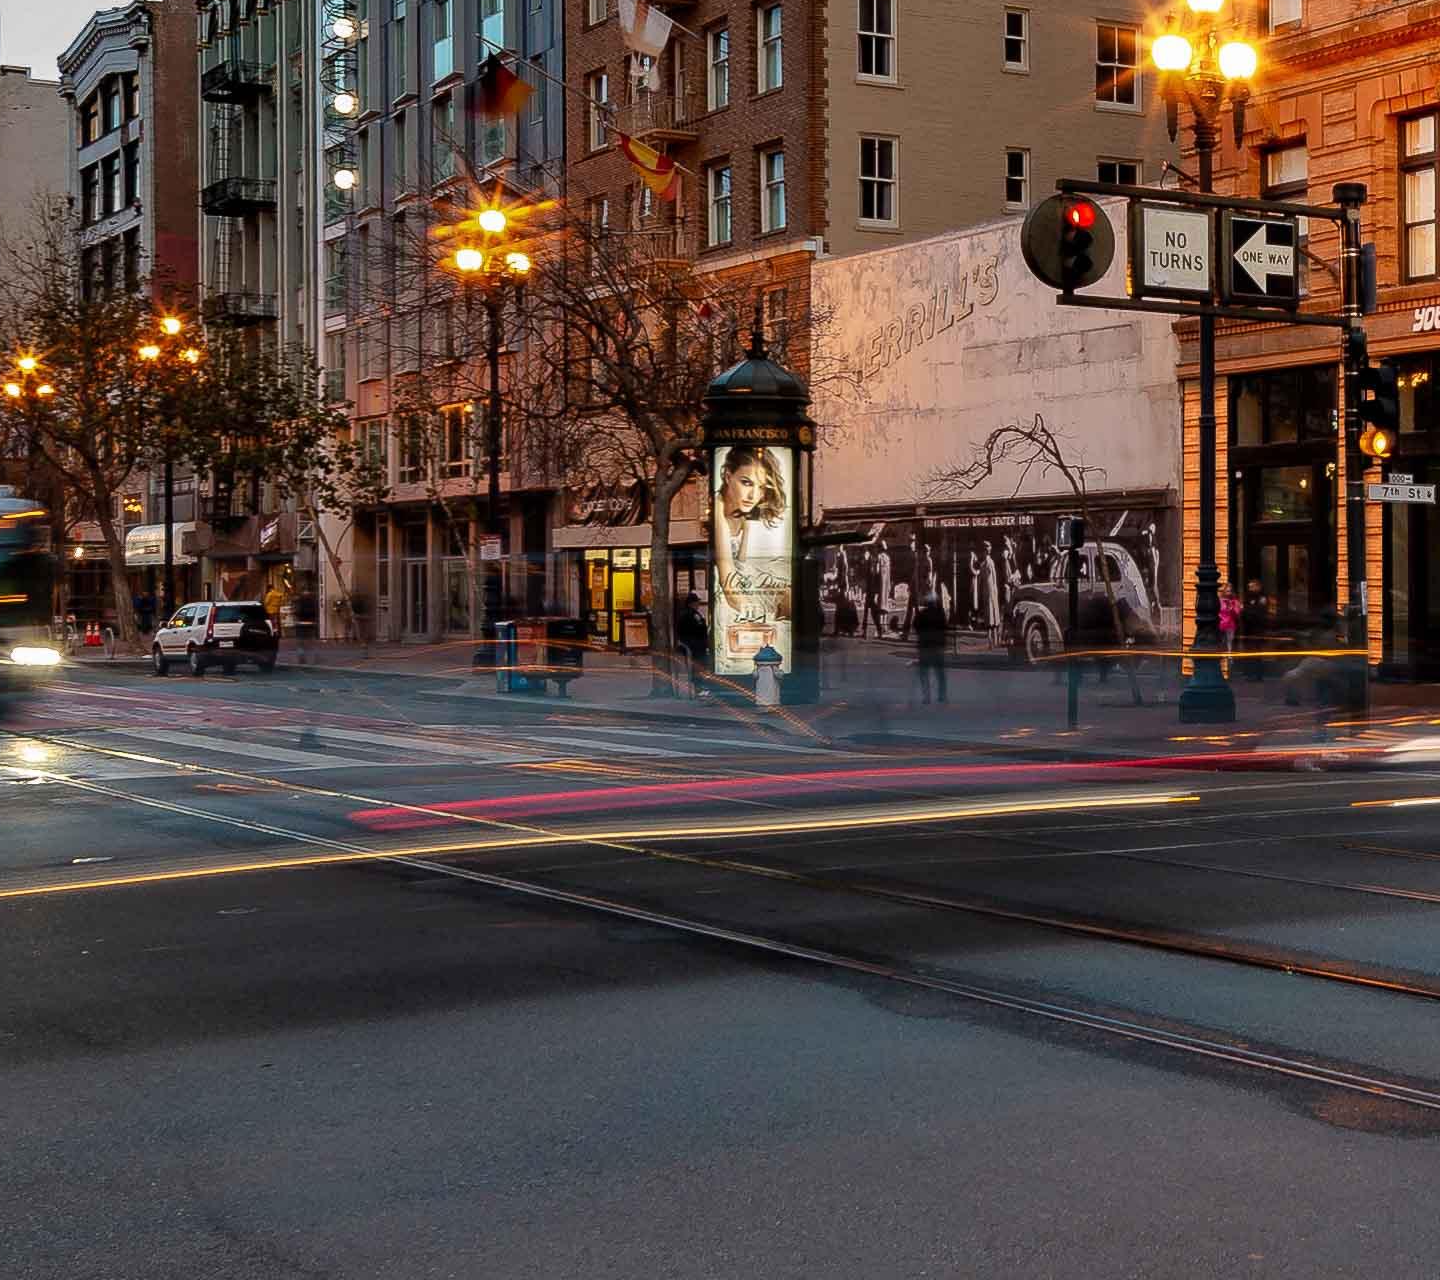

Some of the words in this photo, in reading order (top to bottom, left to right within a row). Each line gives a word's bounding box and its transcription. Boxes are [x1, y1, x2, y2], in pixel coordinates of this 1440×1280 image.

[1164, 231, 1187, 249] NO
[1149, 251, 1204, 271] TURNS
[1241, 250, 1264, 264] ONE
[1267, 253, 1290, 266] WAY
[863, 255, 999, 379] ERRILL'S
[1383, 486, 1400, 497] 7th
[1408, 488, 1421, 499] St
